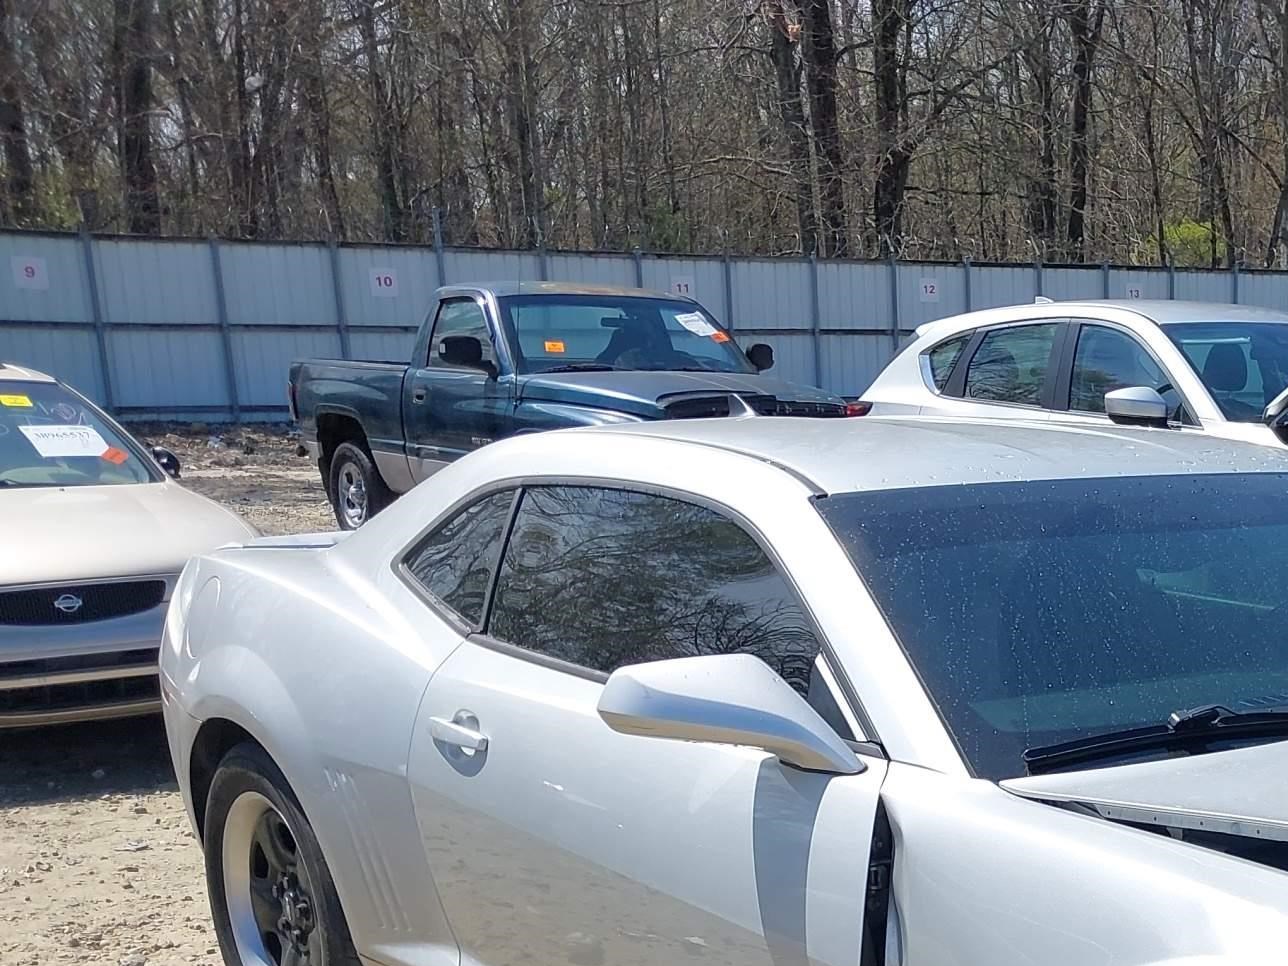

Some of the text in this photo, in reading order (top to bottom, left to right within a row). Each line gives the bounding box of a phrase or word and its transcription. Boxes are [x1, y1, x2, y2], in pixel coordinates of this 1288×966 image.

[24, 266, 35, 278] 9
[376, 276, 393, 287] 10
[677, 283, 689, 293] 11
[924, 285, 936, 294] 12
[1129, 289, 1140, 298] 13
